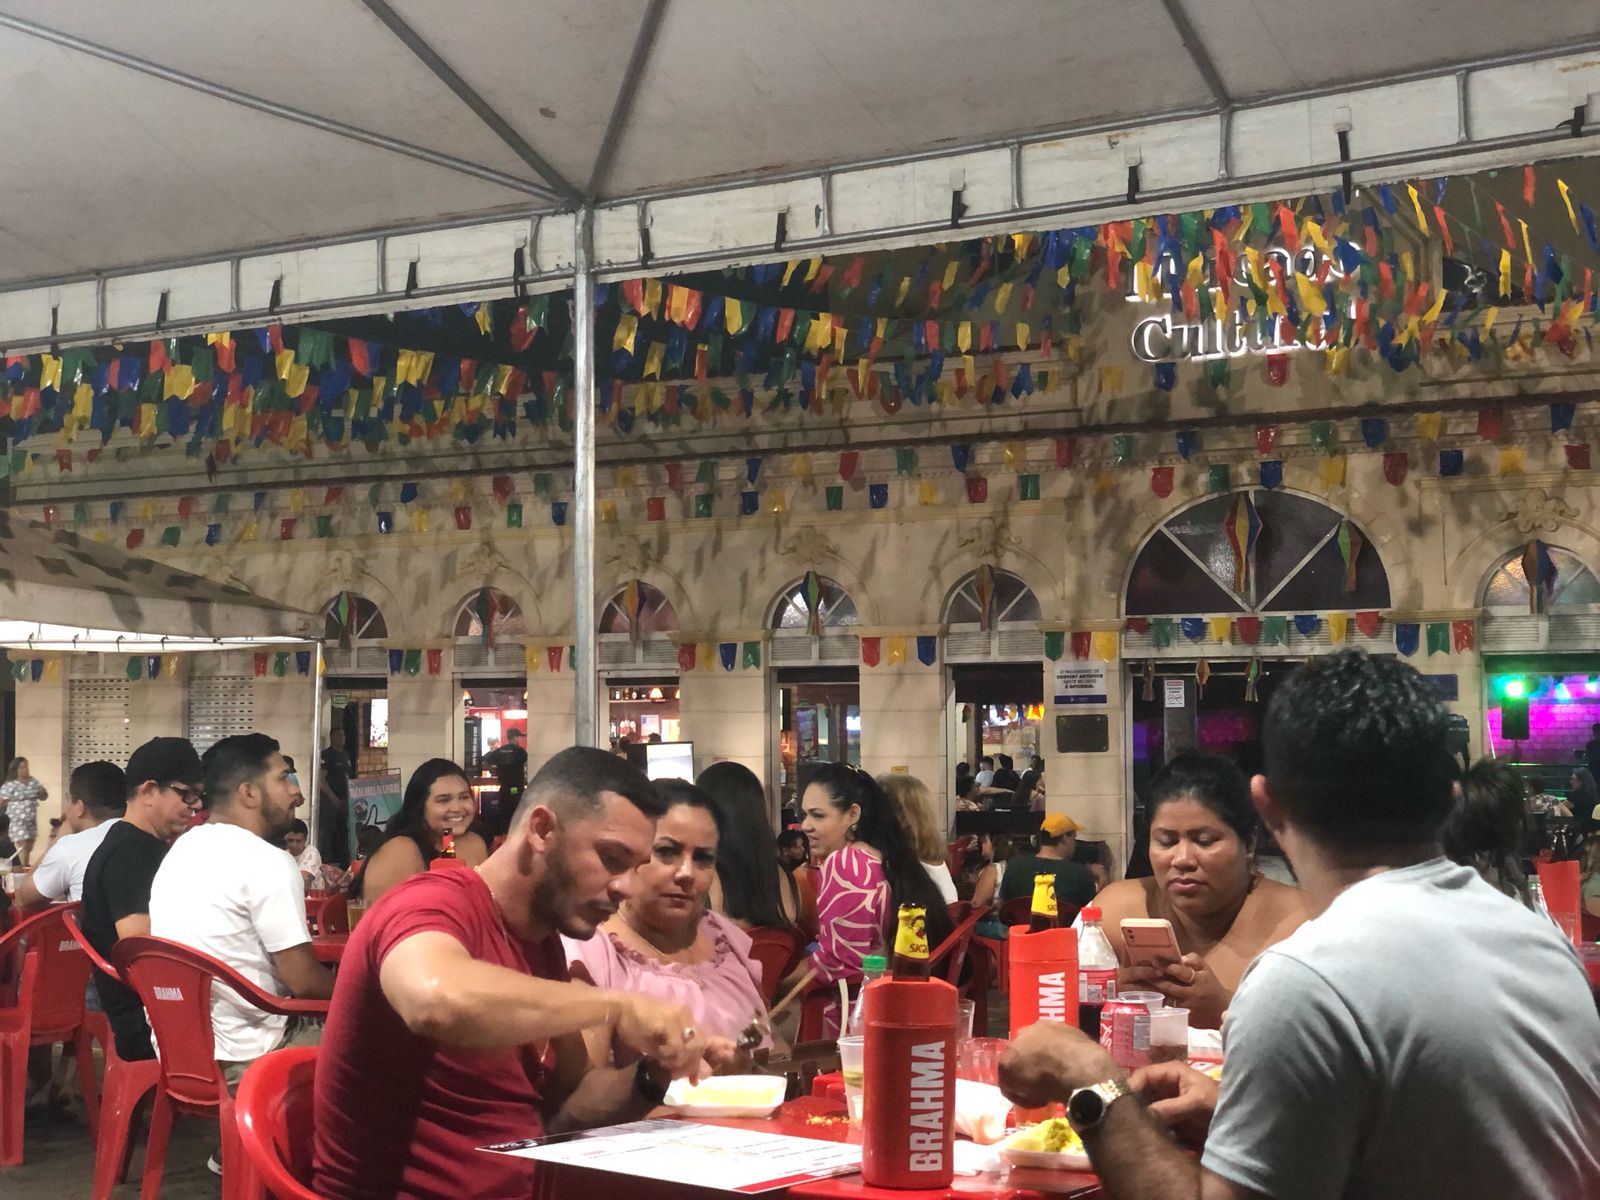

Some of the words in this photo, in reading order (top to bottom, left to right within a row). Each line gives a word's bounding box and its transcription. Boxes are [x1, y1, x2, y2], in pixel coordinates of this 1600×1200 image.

[1131, 305, 1359, 362] Cultura
[153, 986, 184, 1001] BRAHMA
[1038, 971, 1066, 1023] HMA
[909, 1040, 946, 1172] BRAHMA
